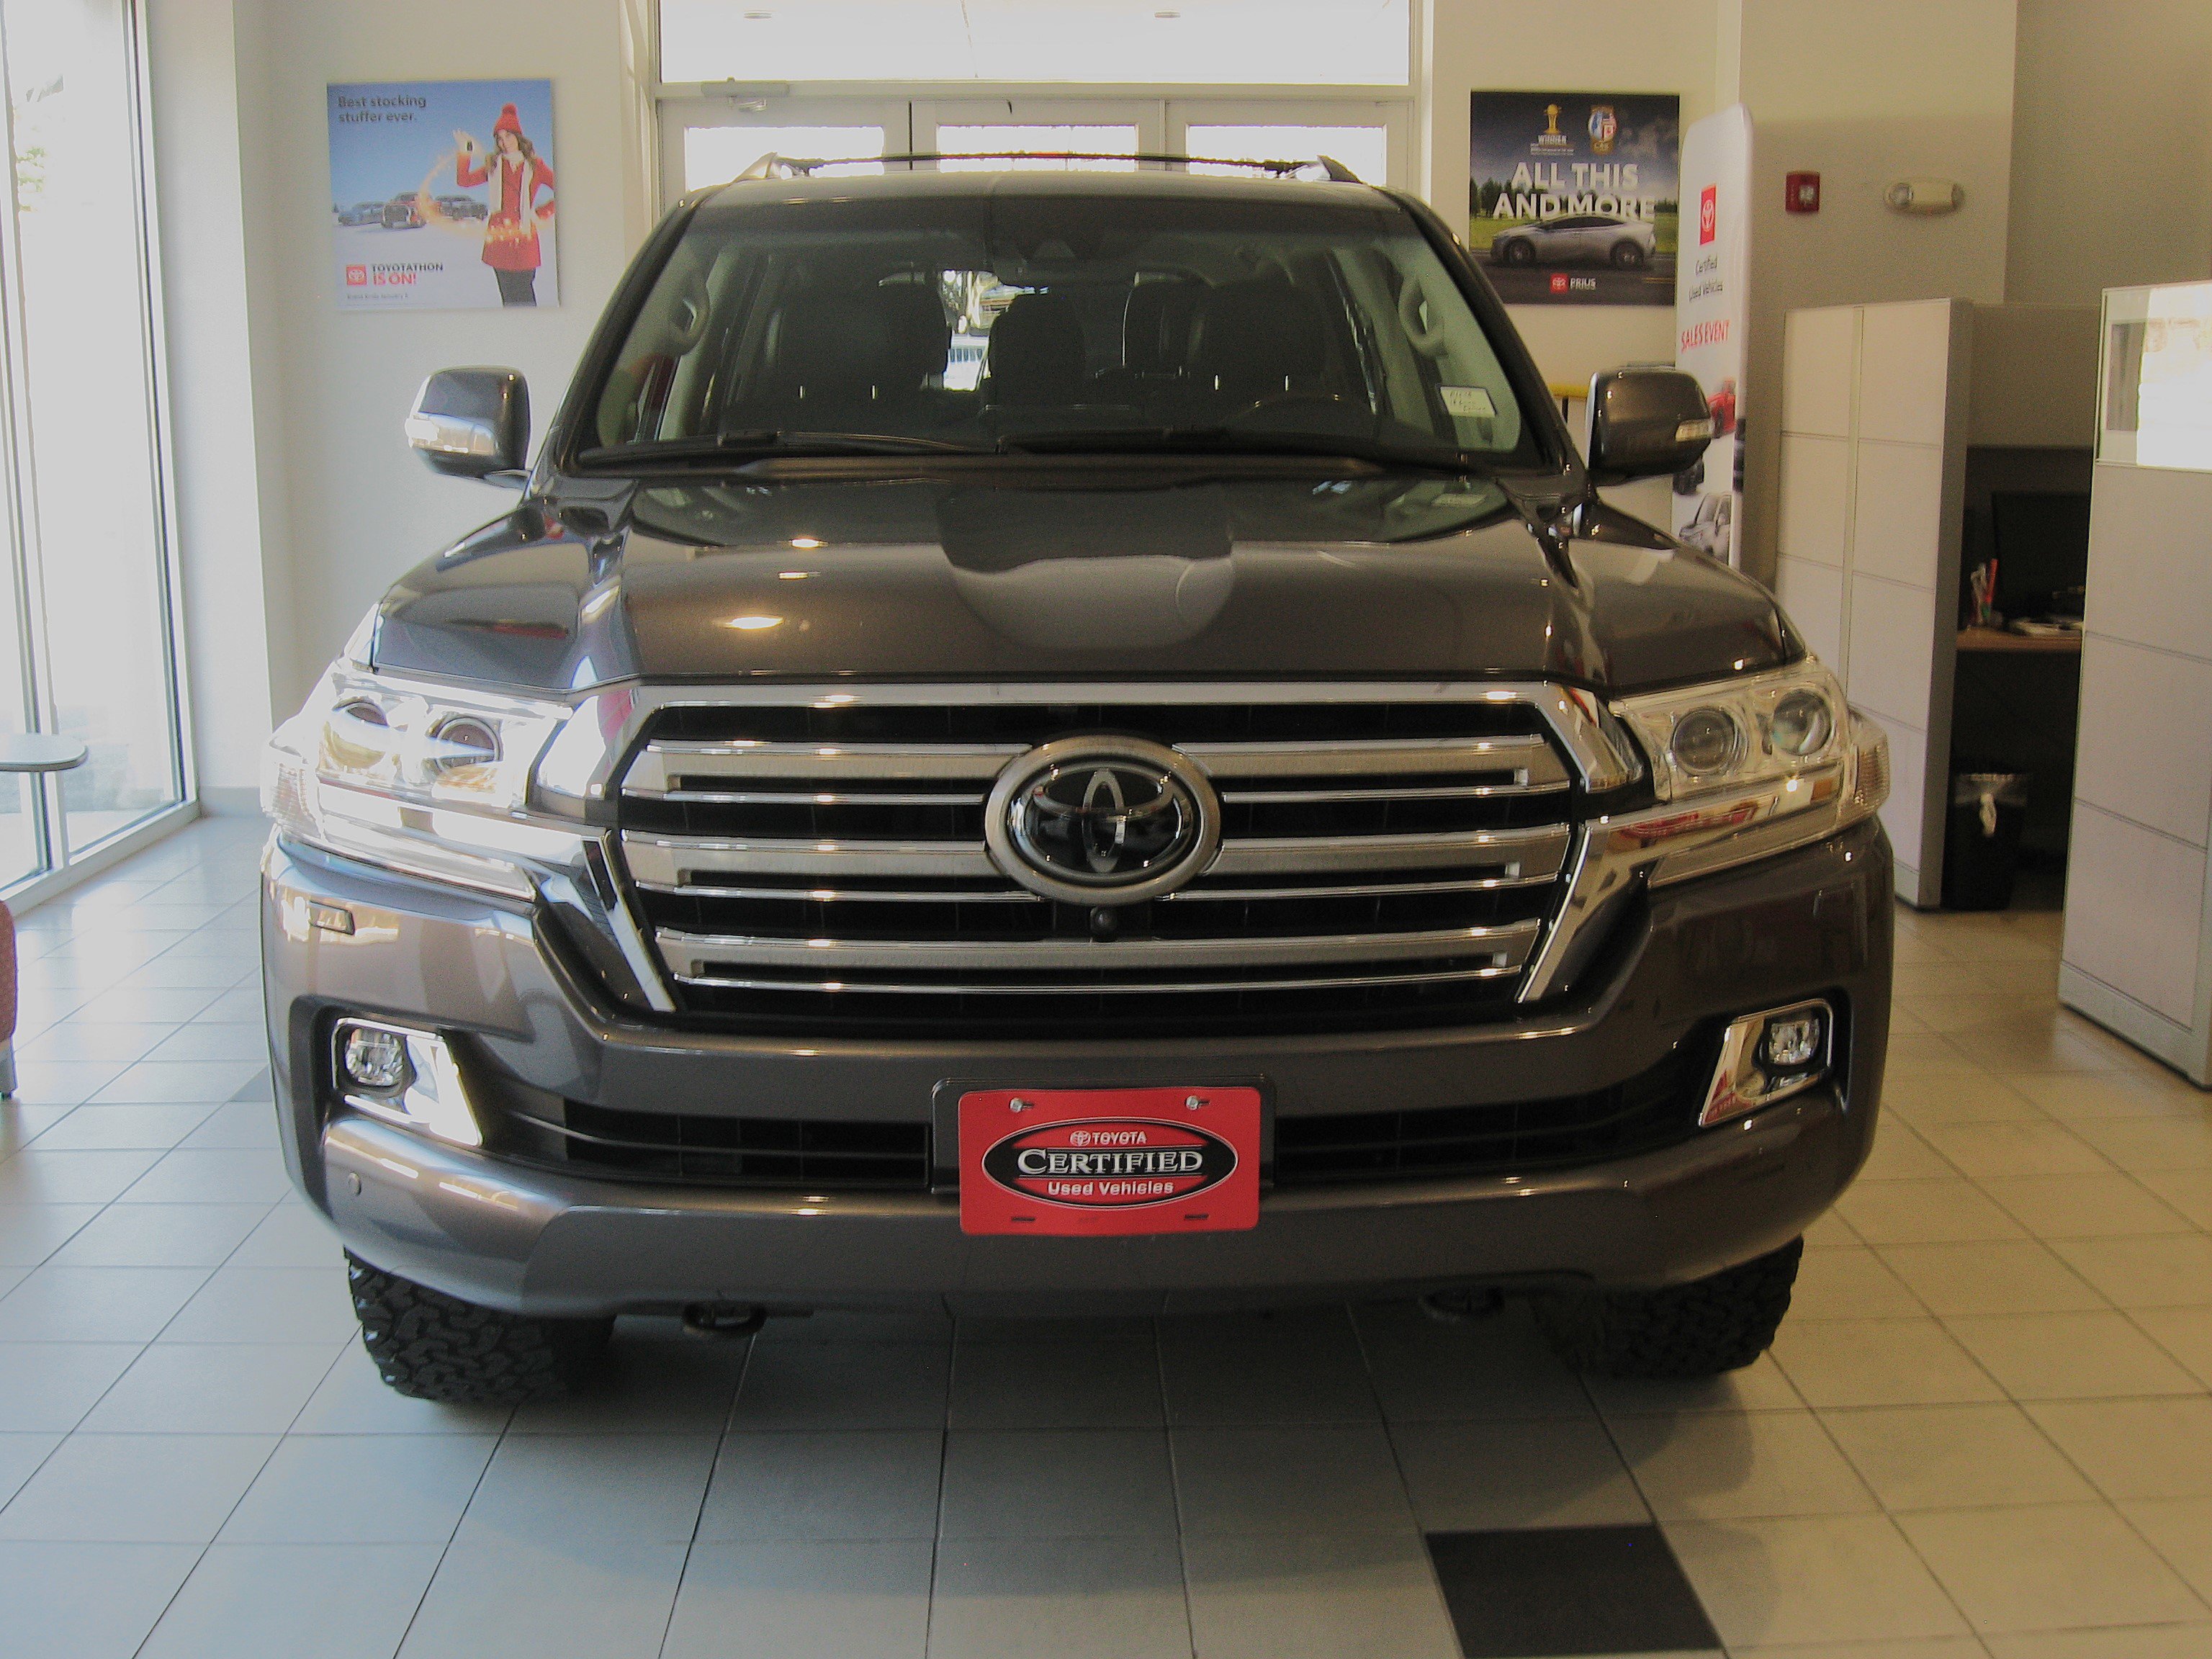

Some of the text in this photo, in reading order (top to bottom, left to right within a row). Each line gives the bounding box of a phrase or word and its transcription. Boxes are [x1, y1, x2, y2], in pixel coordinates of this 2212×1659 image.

[338, 94, 426, 109] Best stocking
[338, 111, 382, 122] stuffer
[1511, 162, 1639, 191] ALL THIS
[1493, 193, 1655, 221] AND MORE
[372, 262, 444, 272] TOYOTATHON
[373, 272, 417, 286] IS ON!
[1570, 277, 1596, 290] PRIUS
[1681, 319, 1730, 354] SALES EVENT
[1092, 1131, 1146, 1145] TOYOTA
[1017, 1148, 1203, 1174] CERTIFIED
[1048, 1181, 1175, 1196] Used Vehicles
